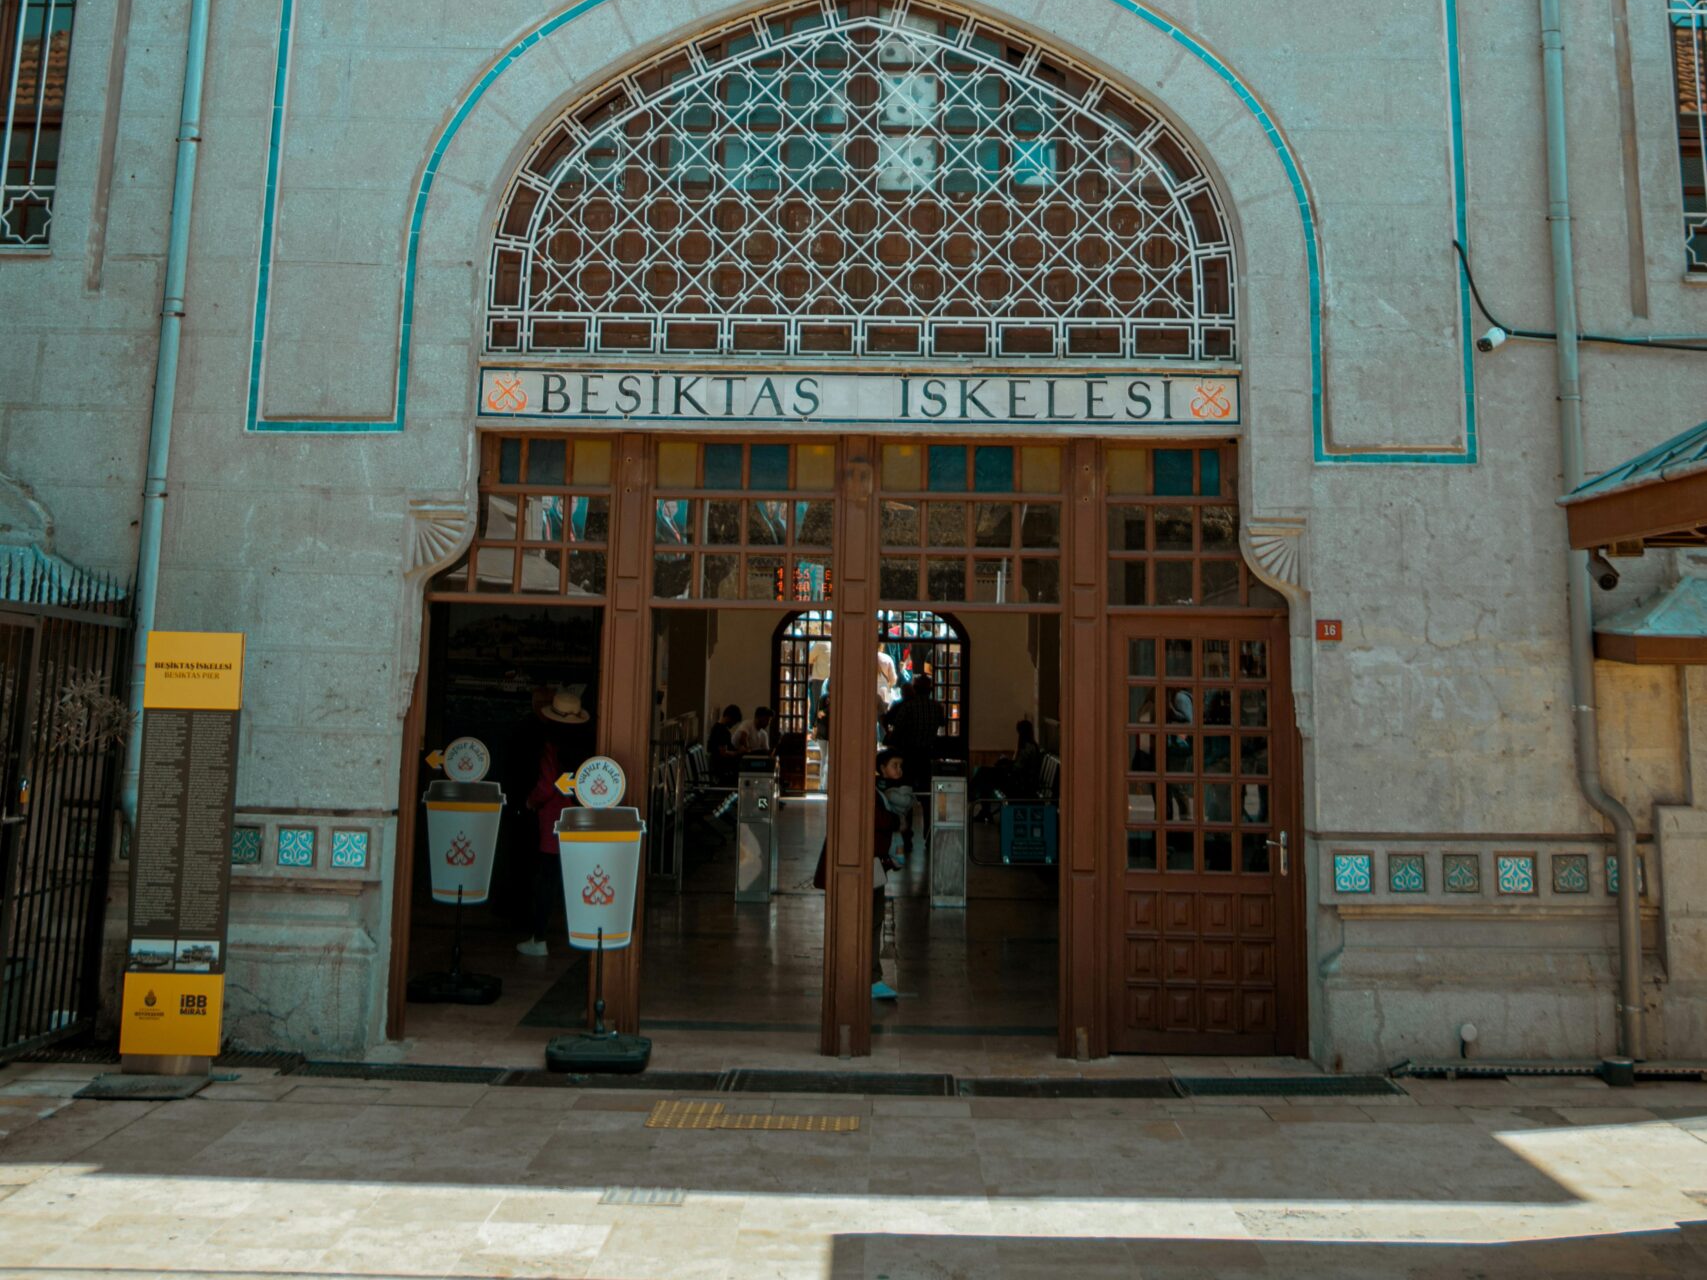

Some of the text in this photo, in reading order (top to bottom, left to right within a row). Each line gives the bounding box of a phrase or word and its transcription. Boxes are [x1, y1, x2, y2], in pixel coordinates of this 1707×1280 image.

[540, 370, 820, 422] BEŞİKTAŞ
[1323, 624, 1336, 636] 16
[579, 761, 620, 784] vapur kafe
